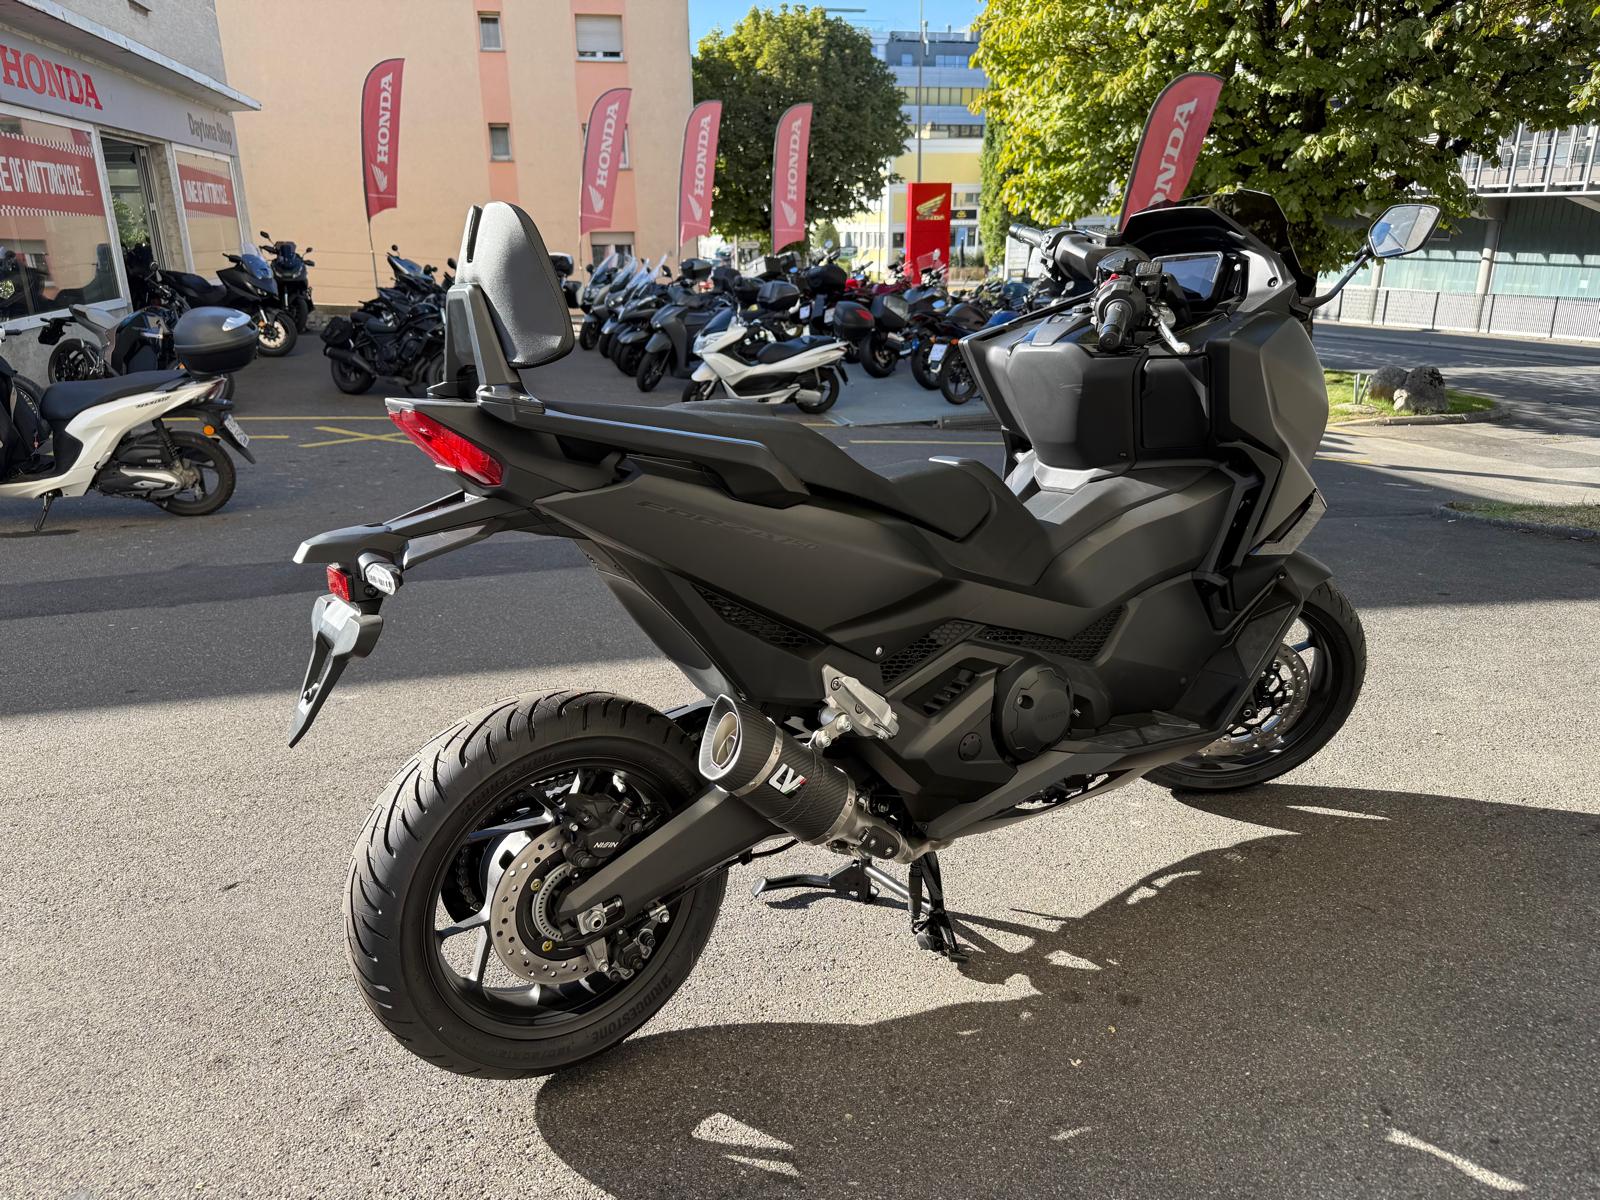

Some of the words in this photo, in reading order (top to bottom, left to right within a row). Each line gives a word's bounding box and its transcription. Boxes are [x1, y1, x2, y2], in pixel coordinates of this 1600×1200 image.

[0, 44, 103, 110] HONDA
[377, 72, 393, 165] HONDA
[9, 156, 24, 193] OF
[596, 101, 620, 188] HONDA
[694, 114, 711, 197] HONDA
[787, 118, 802, 201] HONDA
[1148, 98, 1198, 207] NDA
